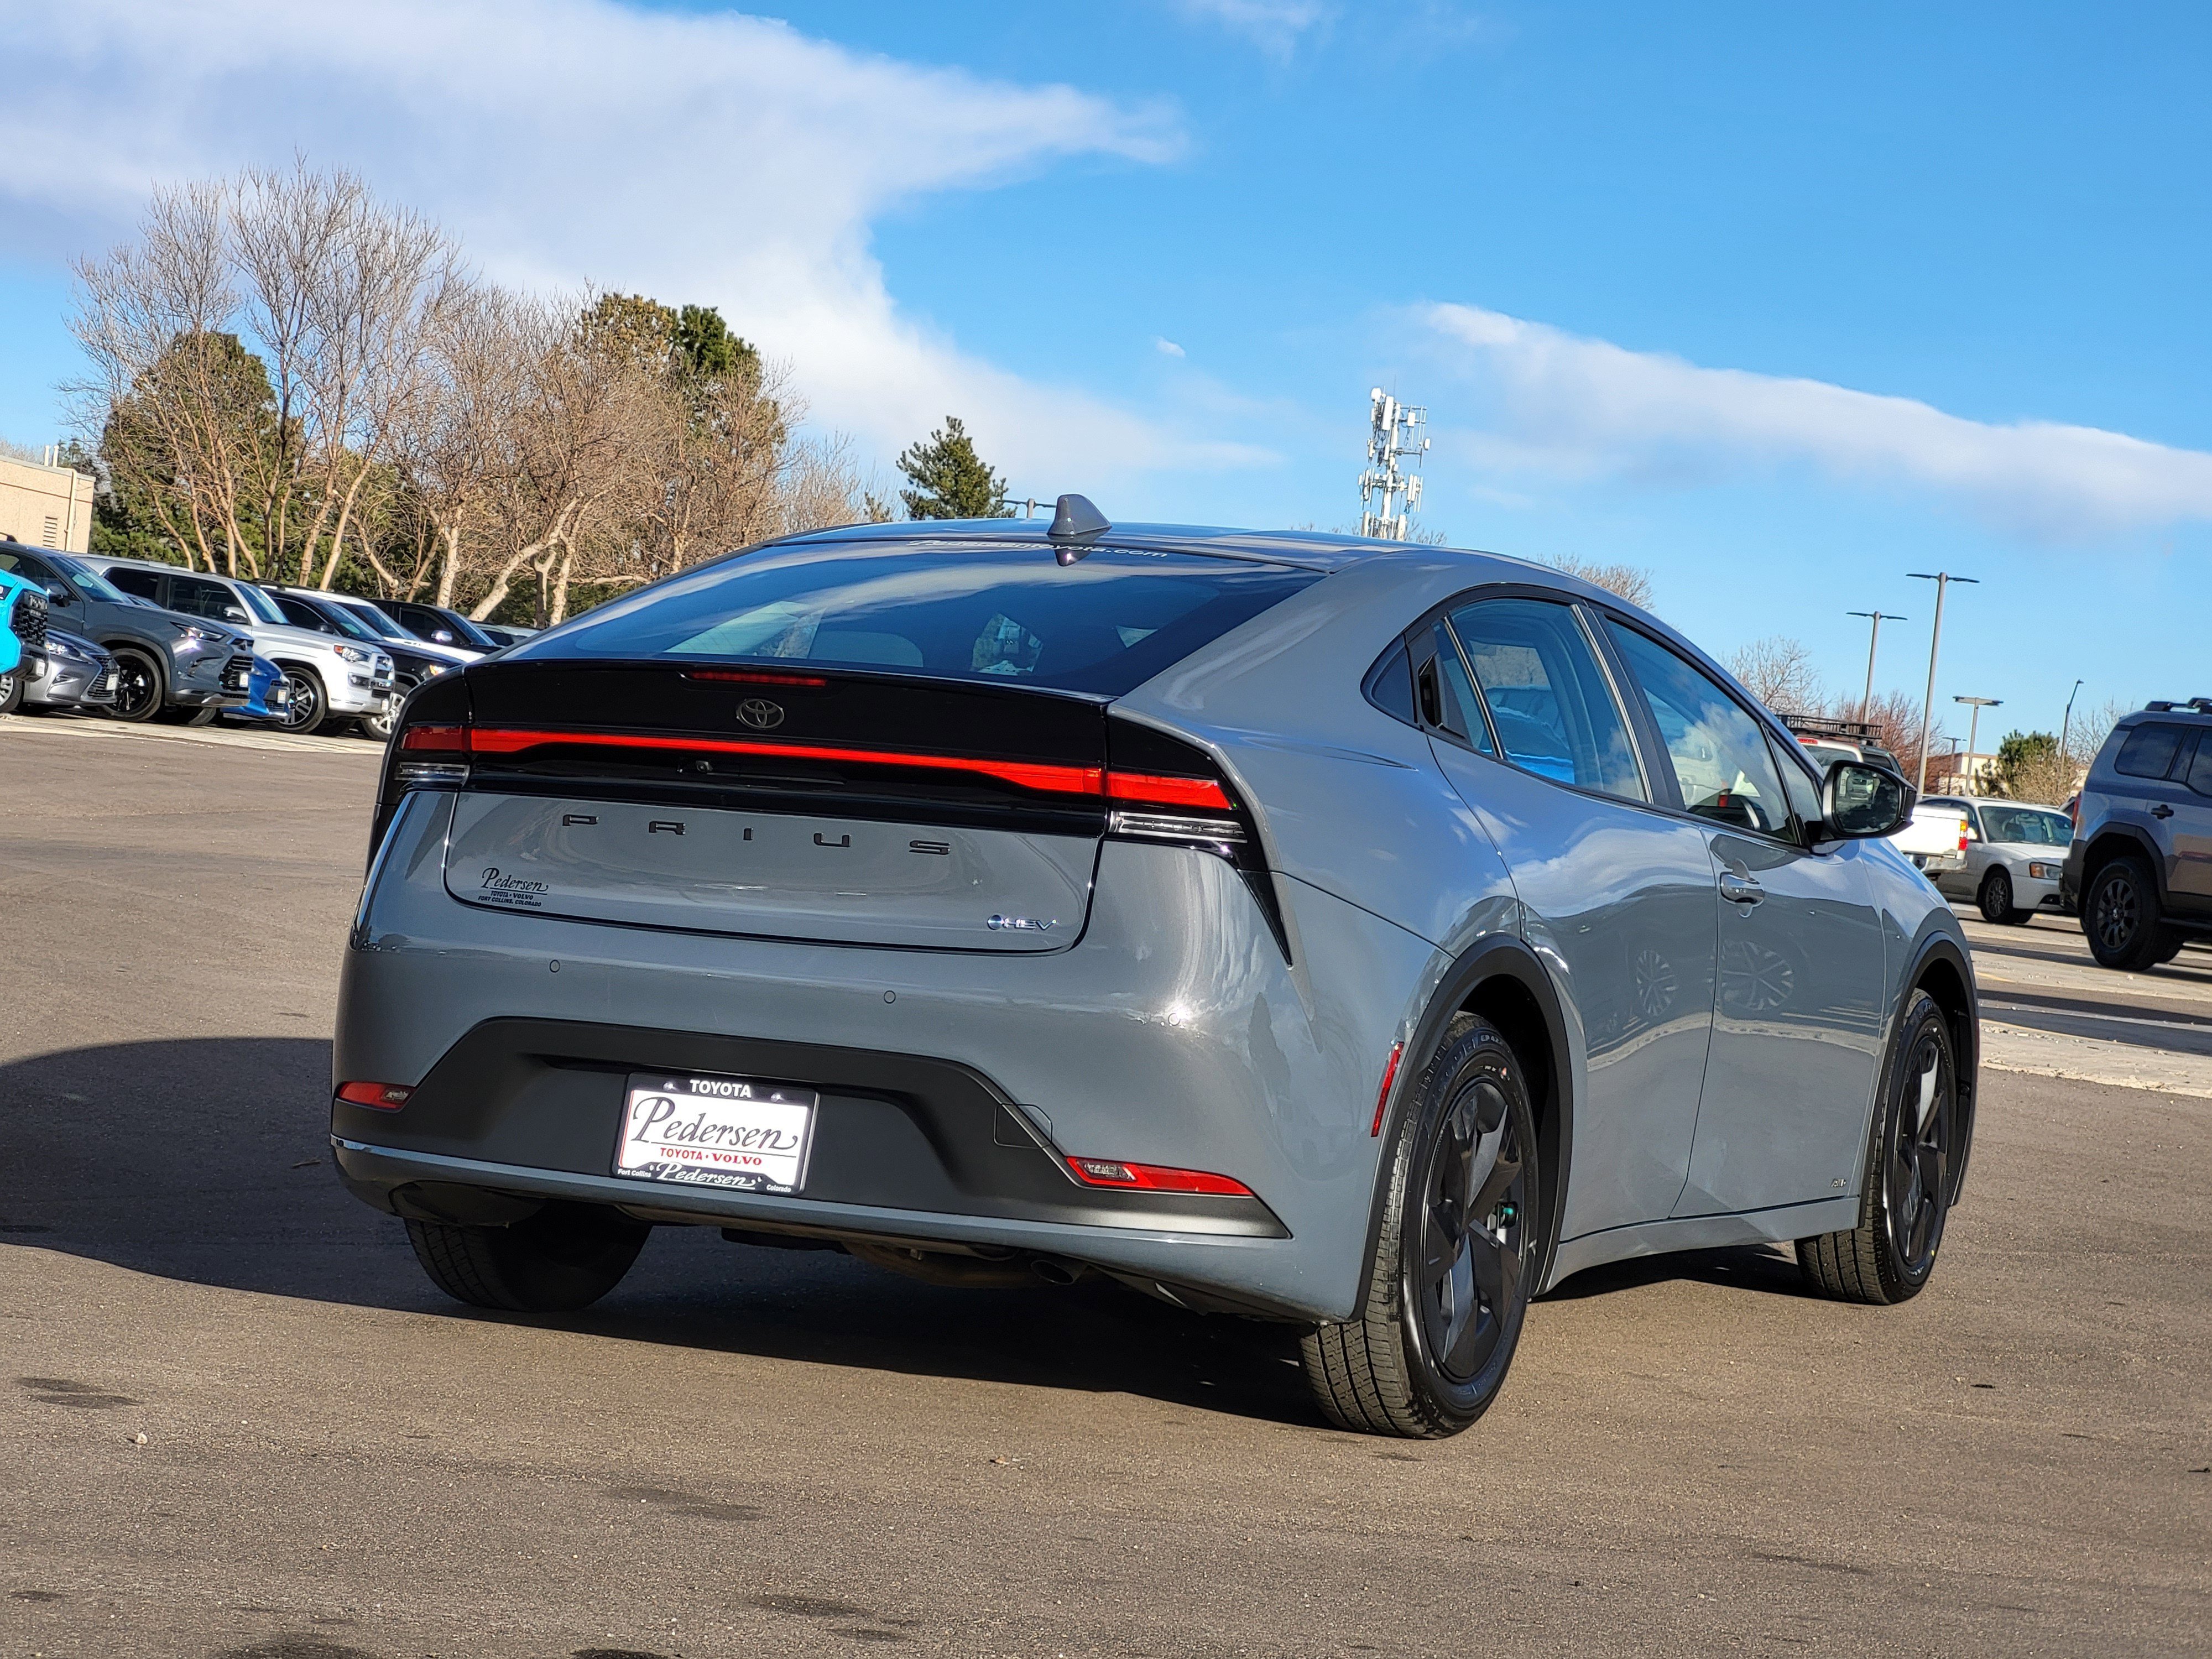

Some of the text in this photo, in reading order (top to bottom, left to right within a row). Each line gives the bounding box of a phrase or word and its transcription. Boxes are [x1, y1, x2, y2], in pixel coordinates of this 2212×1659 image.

[562, 815, 951, 855] PRIUS
[481, 867, 549, 892] Pedersen
[690, 1079, 752, 1098] TOYOTA
[631, 1097, 798, 1150] Pedersen
[660, 1147, 762, 1165] TOYOTA VOLVO
[631, 1170, 651, 1178] Collins
[656, 1161, 756, 1187] Pedersen
[766, 1184, 791, 1193] Colorado
